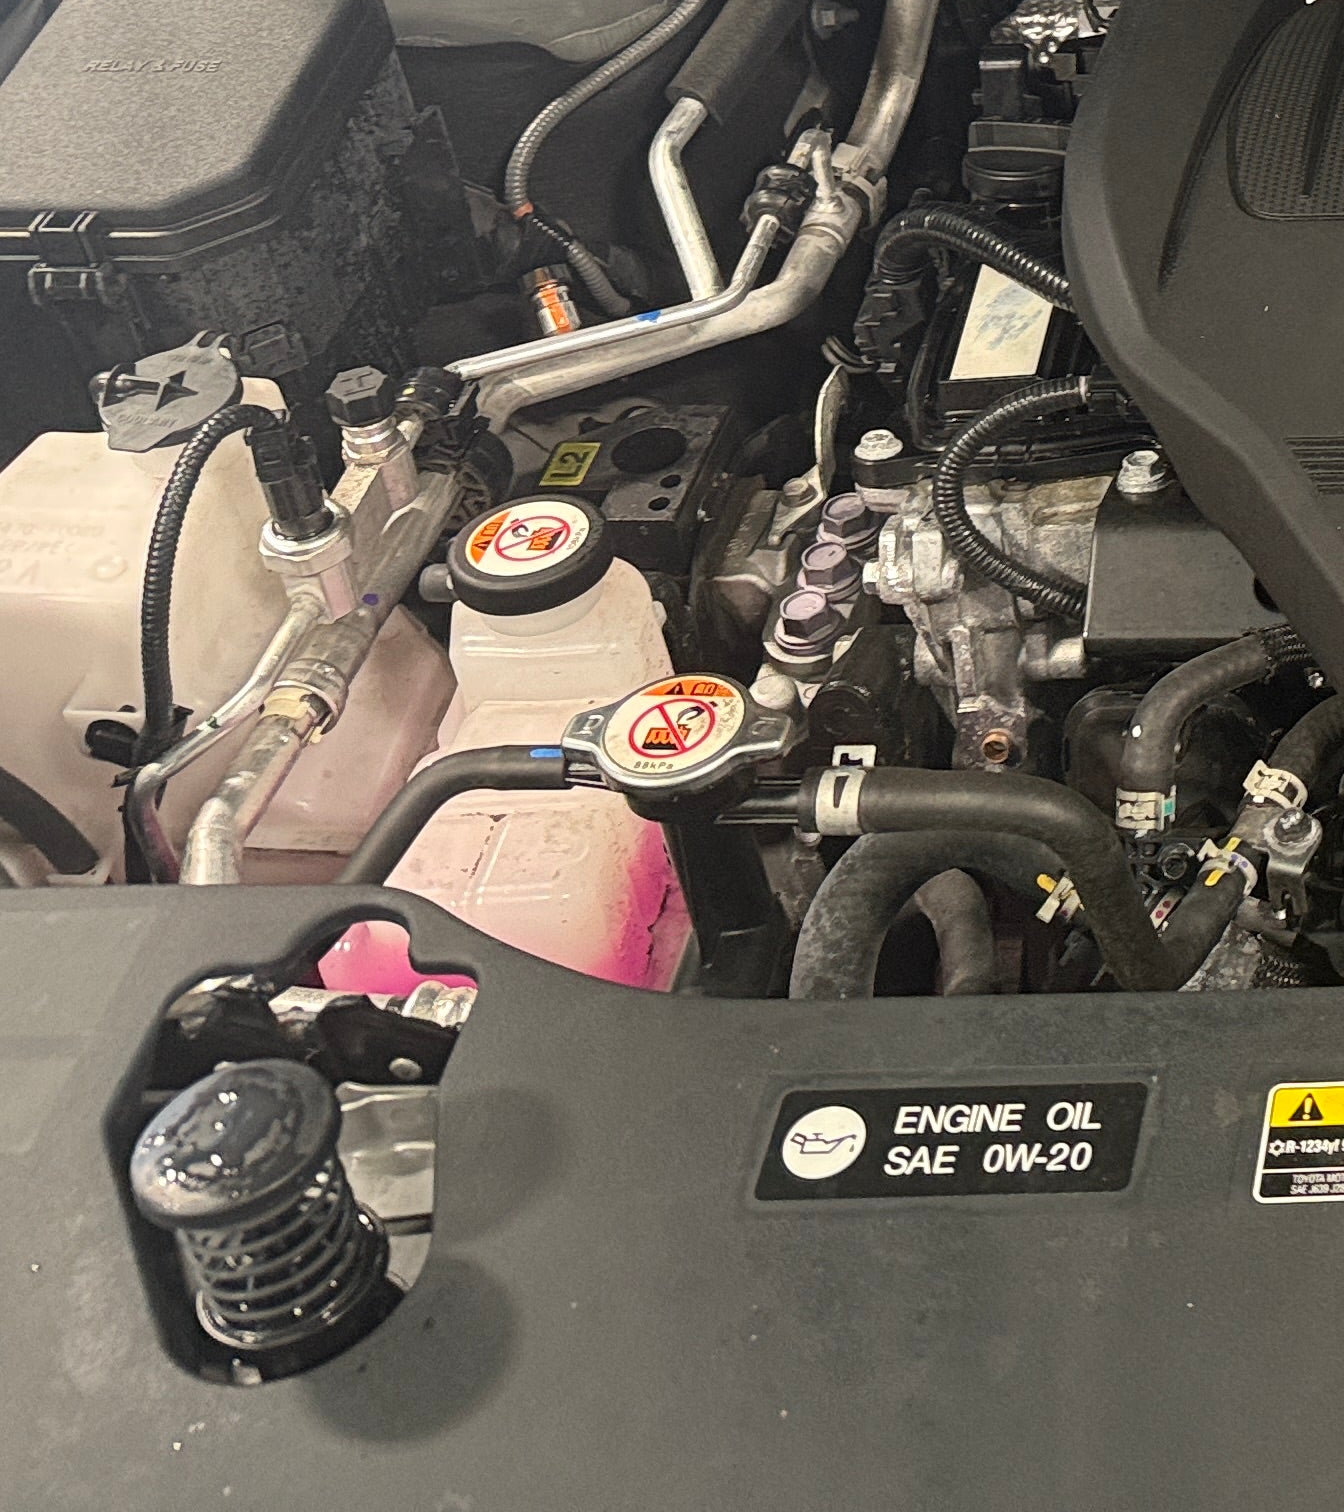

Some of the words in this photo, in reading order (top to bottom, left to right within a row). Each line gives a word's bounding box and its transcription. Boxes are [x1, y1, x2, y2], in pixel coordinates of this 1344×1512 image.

[82, 59, 151, 73] RELAY
[169, 59, 223, 74] FUSE
[633, 760, 675, 770] 88kPa
[893, 1102, 1026, 1135] ENGINE
[1045, 1100, 1102, 1132] OIL
[1285, 1138, 1340, 1155] R-1234yf
[883, 1143, 961, 1177] SAE
[982, 1141, 1093, 1175] 0W-20
[1292, 1172, 1325, 1184] TOYOTA
[1289, 1183, 1308, 1195] SAE
